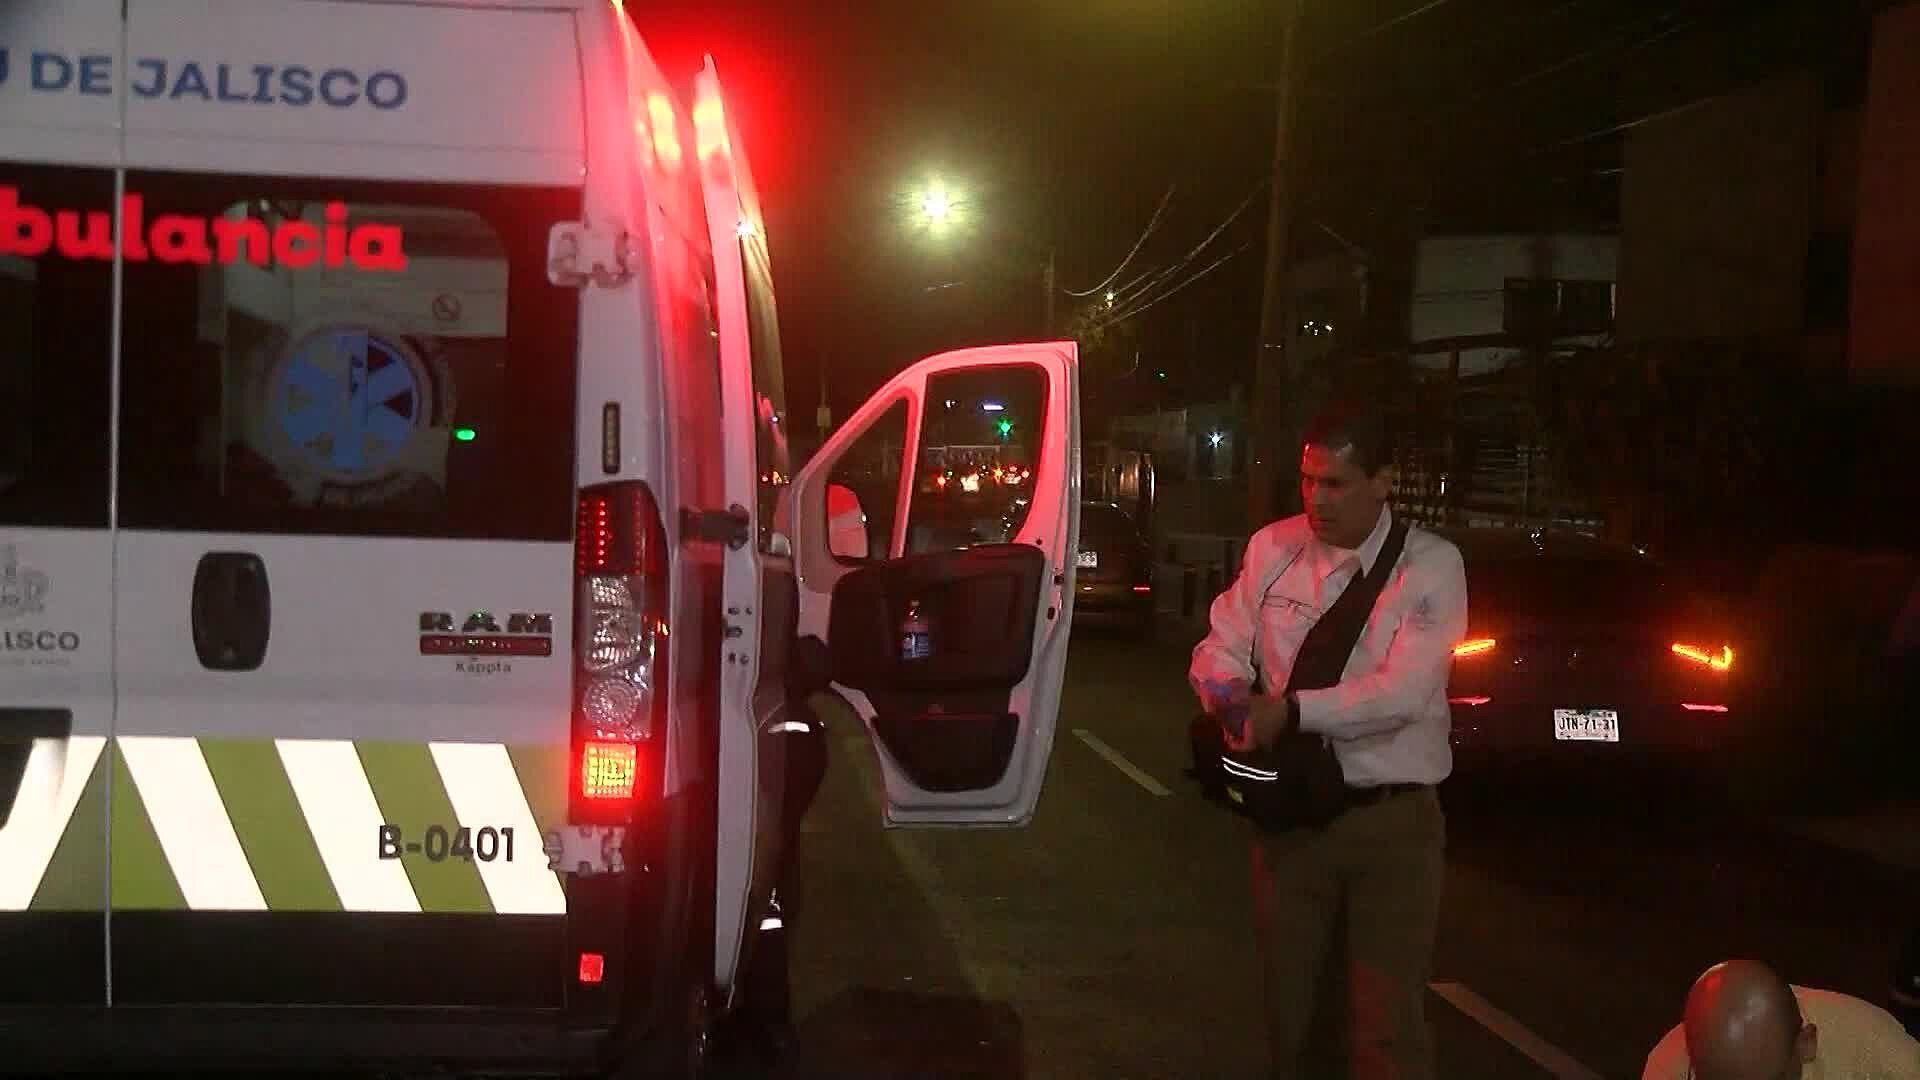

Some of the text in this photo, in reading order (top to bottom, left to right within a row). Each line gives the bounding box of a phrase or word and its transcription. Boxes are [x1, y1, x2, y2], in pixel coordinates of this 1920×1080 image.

[31, 51, 113, 94] DE
[131, 58, 409, 110] JALISCO
[0, 184, 408, 272] bulancia
[420, 612, 553, 633] RAM
[379, 825, 514, 863] B-0401
